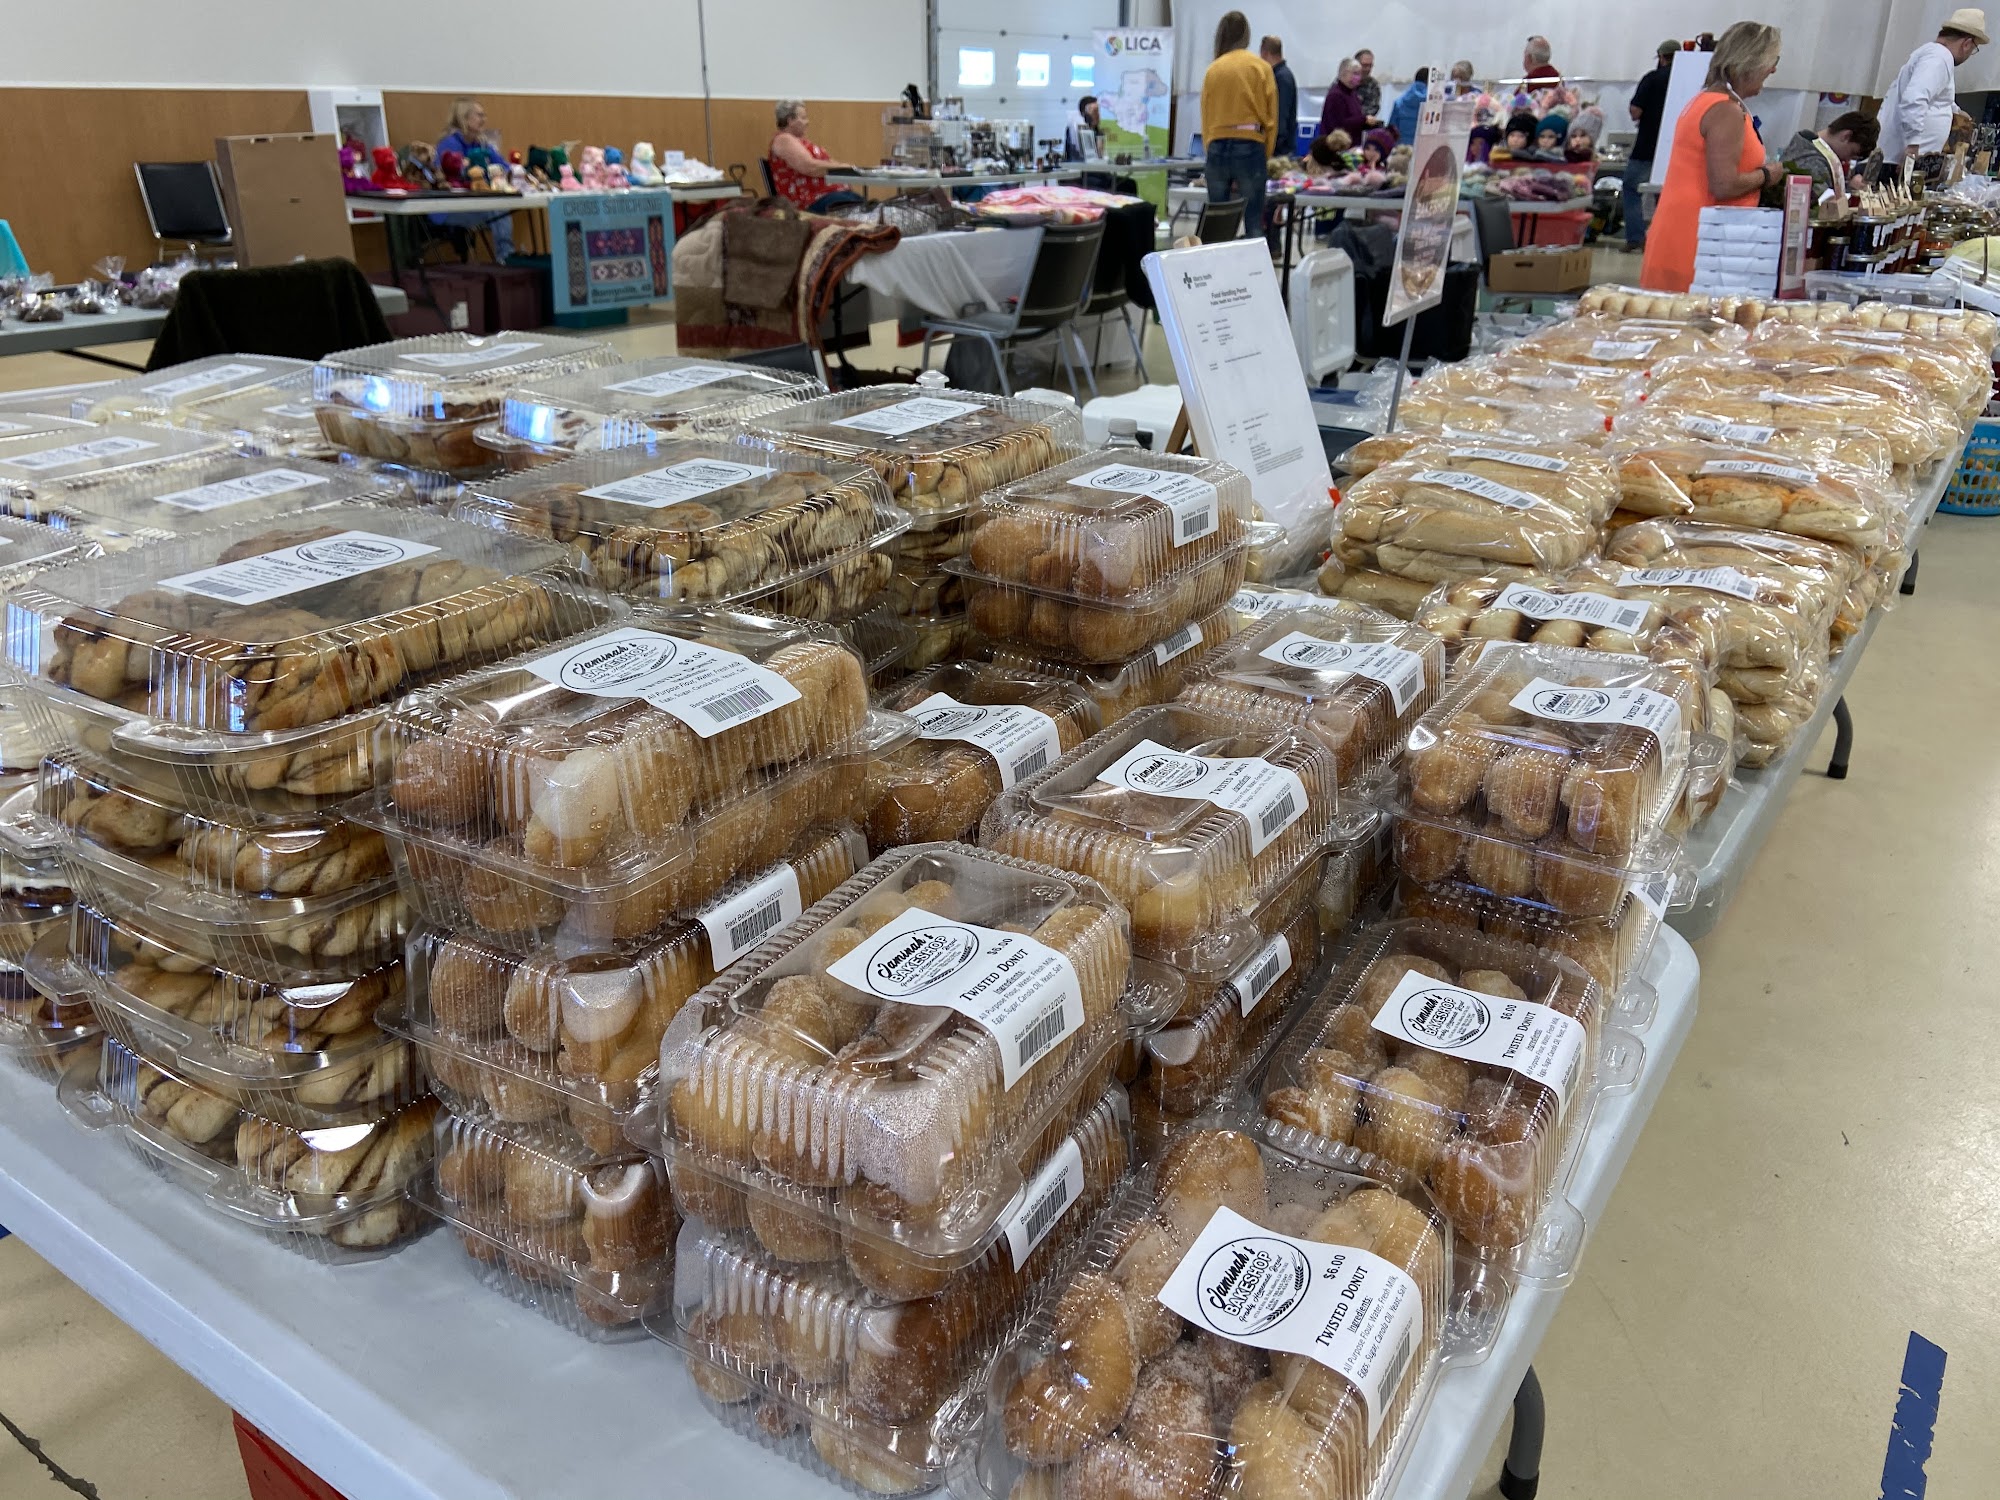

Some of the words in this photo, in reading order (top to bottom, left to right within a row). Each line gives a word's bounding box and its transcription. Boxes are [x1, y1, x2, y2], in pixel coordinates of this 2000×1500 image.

[1125, 37, 1162, 51] LICA
[572, 642, 637, 676] Jaminah's
[656, 684, 680, 697] Purpose
[689, 700, 703, 709] Best
[724, 918, 738, 930] Best
[877, 932, 934, 979] Jaminah's
[888, 935, 948, 983] BAKESHOP
[986, 938, 1013, 956] $6.00
[959, 972, 1000, 1002] TWISTED
[996, 948, 1029, 973] DONUT
[1003, 1000, 1021, 1015] Sugar,
[1017, 988, 1035, 1004] Canola
[1053, 964, 1064, 974] Salt
[978, 1011, 988, 1022] All
[985, 996, 1008, 1015] Purpose
[1030, 964, 1046, 977] Fresh
[1424, 997, 1456, 1037] BAKESHOP
[1014, 1031, 1025, 1043] Best
[1501, 1033, 1525, 1059] TWISTED
[1517, 1011, 1537, 1032] DONUT
[1206, 1244, 1256, 1309] Jaminah's
[1322, 1254, 1346, 1280] $6.00
[1223, 1250, 1272, 1317] BAKESHOP
[1252, 1273, 1273, 1303] Homemade
[1397, 1284, 1408, 1298] Salt
[1315, 1302, 1349, 1347] TWISTED
[1341, 1266, 1368, 1300] DONUT
[1346, 1295, 1374, 1334] Ingredients:
[1384, 1312, 1395, 1327] Oil,
[1389, 1296, 1402, 1315] Yeast,
[1343, 1362, 1353, 1374] All
[1348, 1339, 1366, 1365] Purpose
[1360, 1322, 1375, 1341] Flour,
[1368, 1304, 1384, 1324] Water,
[1378, 1289, 1391, 1305] Fresh
[1386, 1275, 1399, 1291] Milk,
[1374, 1322, 1389, 1344] Canola
[1364, 1341, 1380, 1362] Sugar,
[1357, 1361, 1371, 1379] Eggs,
